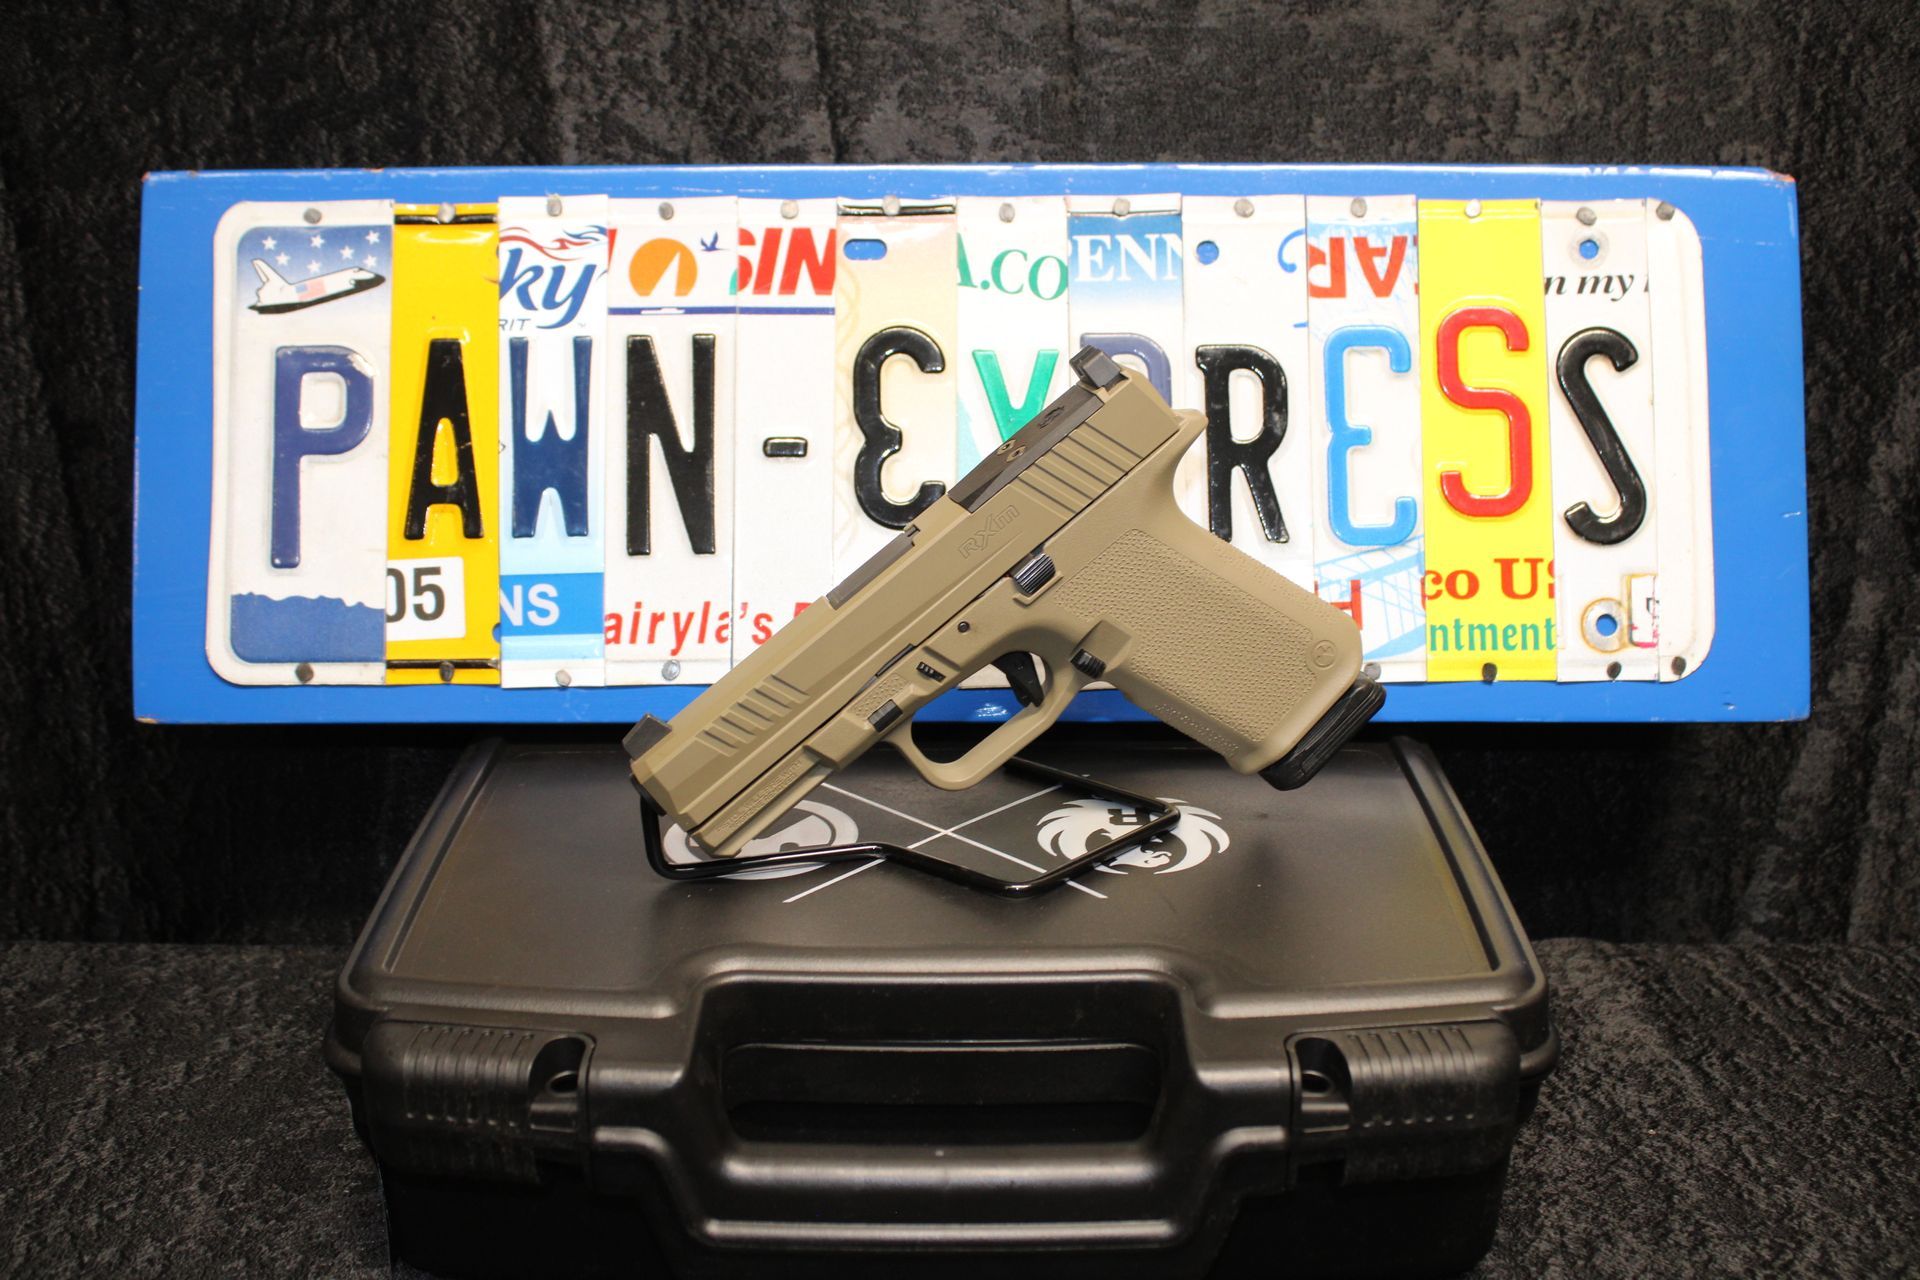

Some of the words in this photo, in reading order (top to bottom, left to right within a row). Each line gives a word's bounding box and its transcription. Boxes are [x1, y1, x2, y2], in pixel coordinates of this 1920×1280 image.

[499, 247, 598, 329] ky
[1577, 275, 1635, 302] my
[387, 566, 445, 623] 05
[500, 583, 560, 627] NS
[1430, 618, 1556, 652] ntment
